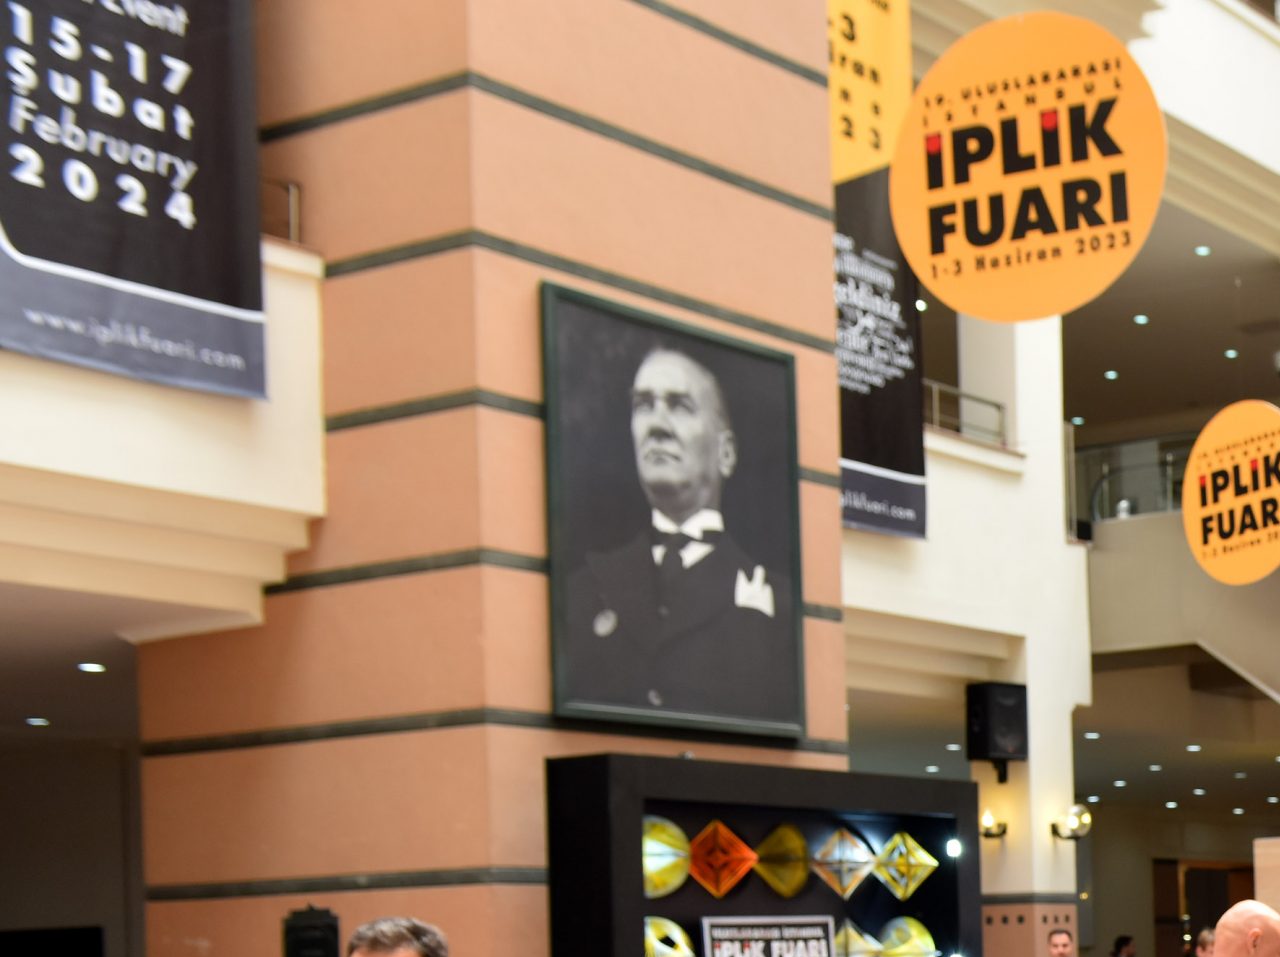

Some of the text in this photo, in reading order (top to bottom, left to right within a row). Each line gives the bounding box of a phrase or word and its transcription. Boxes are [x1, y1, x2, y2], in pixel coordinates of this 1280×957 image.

[8, 94, 199, 191] February
[8, 142, 198, 230] 2024
[928, 171, 1129, 255] FUARI
[975, 247, 1062, 270] Haziran
[1076, 230, 1131, 253] 2023
